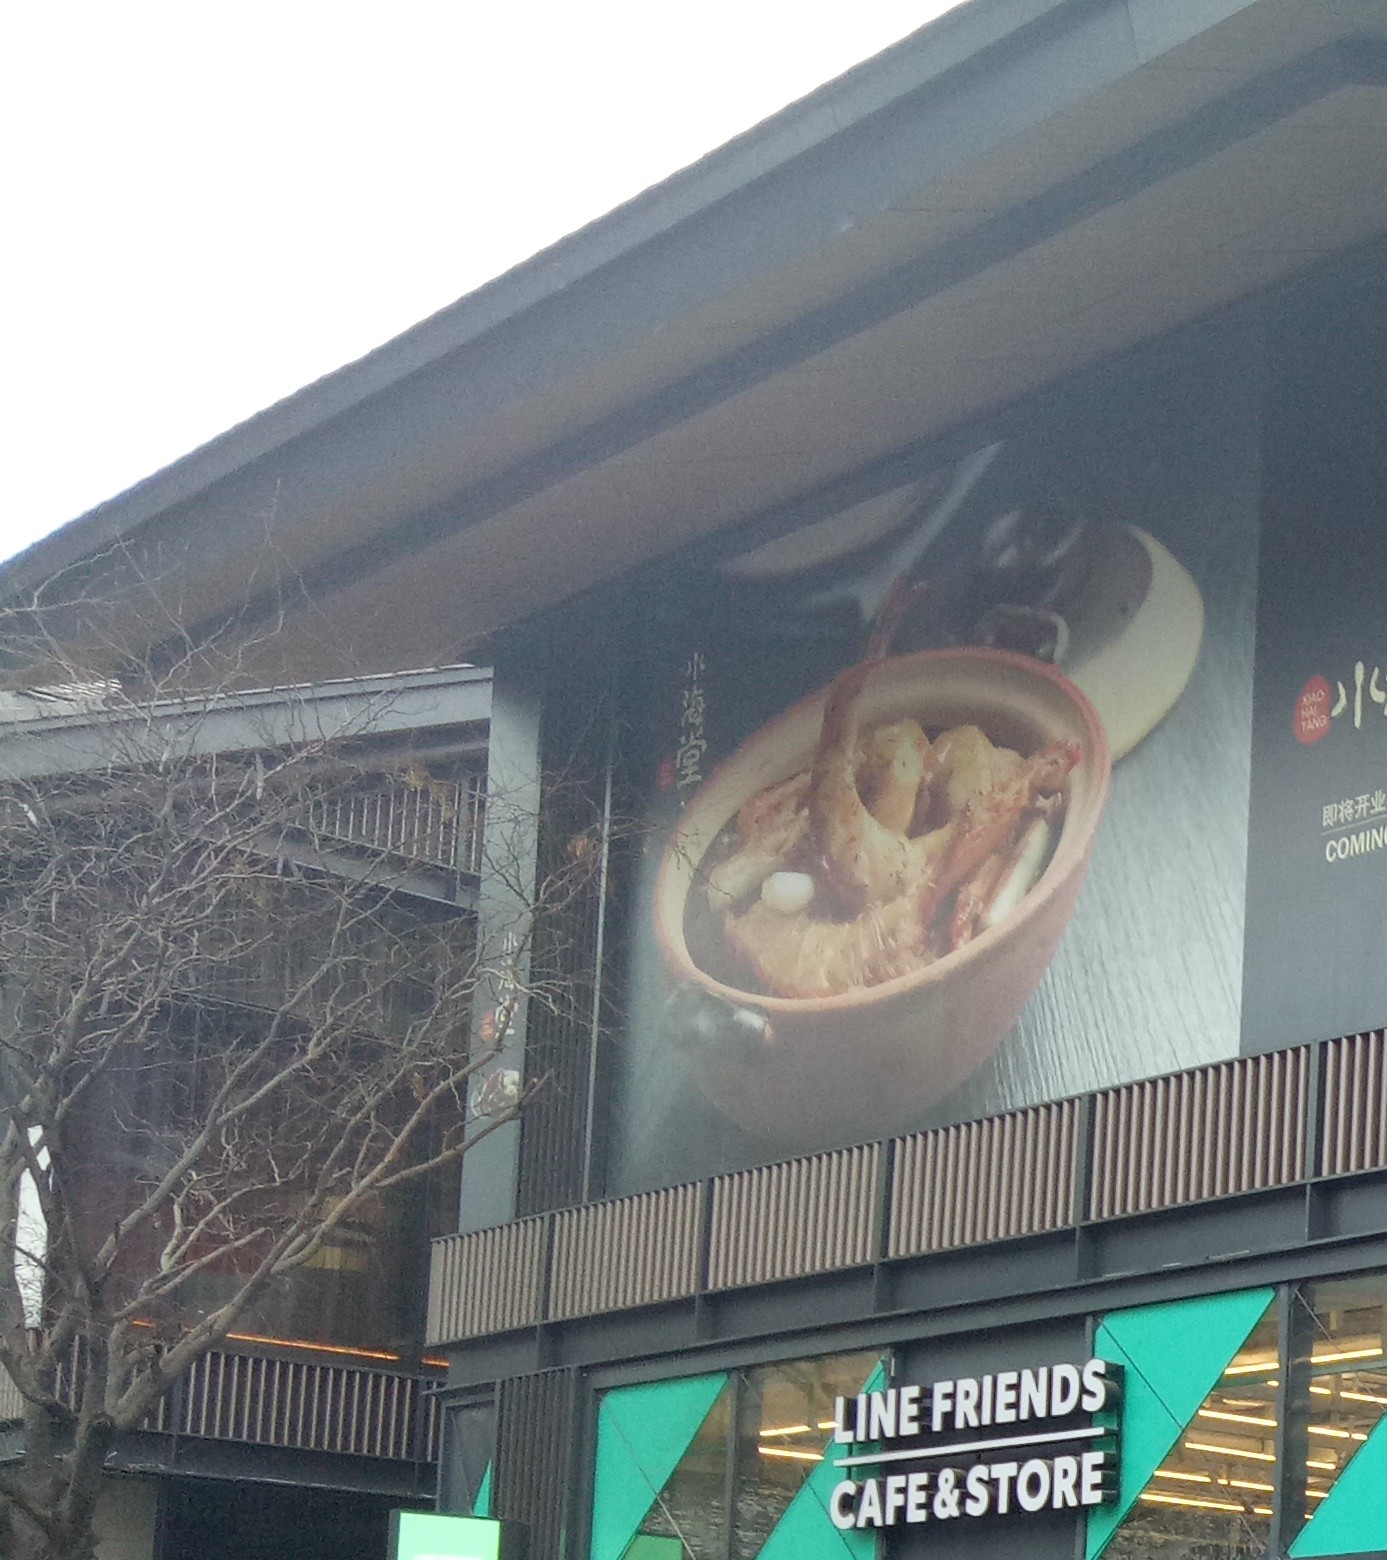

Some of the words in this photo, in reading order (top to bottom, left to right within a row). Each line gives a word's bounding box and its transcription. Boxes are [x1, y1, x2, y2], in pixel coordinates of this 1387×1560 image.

[1322, 790, 1387, 827] 即将开业
[834, 1385, 921, 1443] LINE
[932, 1359, 1106, 1432] FRIENDS
[830, 1451, 1105, 1530] CAFE&STORE
